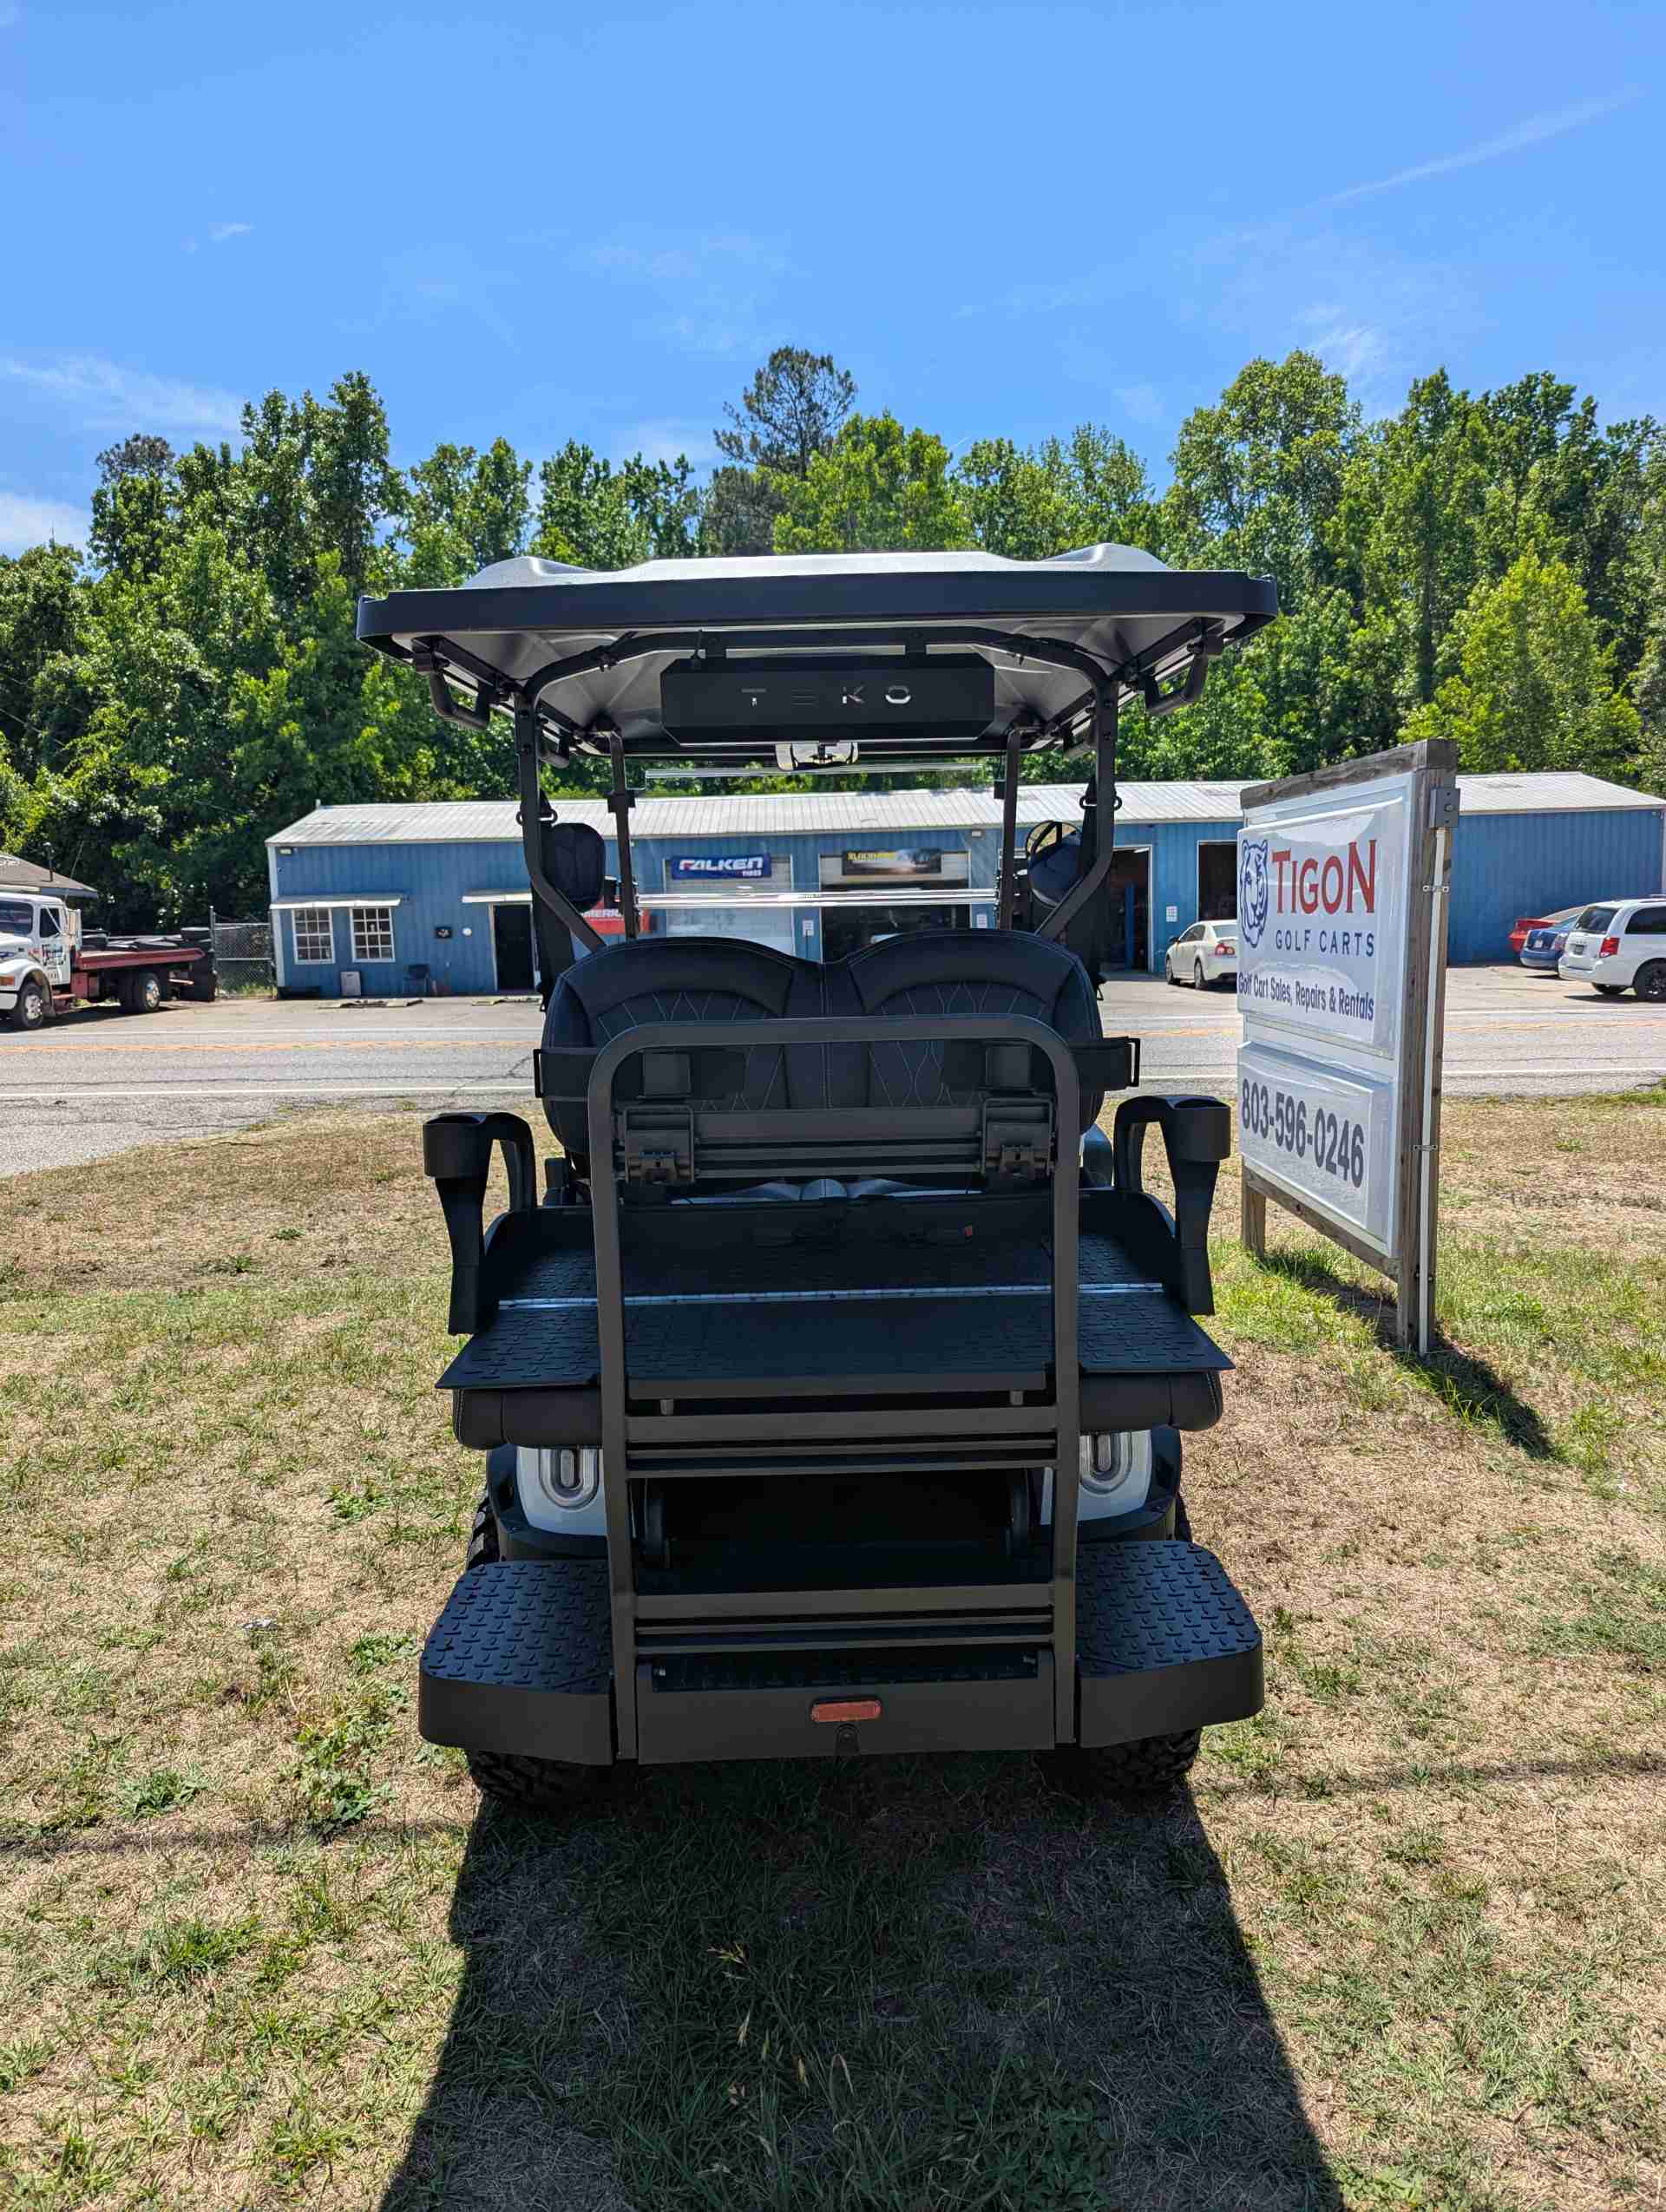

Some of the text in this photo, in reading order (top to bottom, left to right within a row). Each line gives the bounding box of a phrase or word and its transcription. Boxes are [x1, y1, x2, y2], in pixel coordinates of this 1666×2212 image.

[1271, 839, 1376, 914] TIGON
[1276, 929, 1374, 957] GOLF CARTS
[1238, 971, 1374, 1021] Golf Cart Sales, Repairs & Rentals
[1242, 1077, 1365, 1188] 803-596-0246
